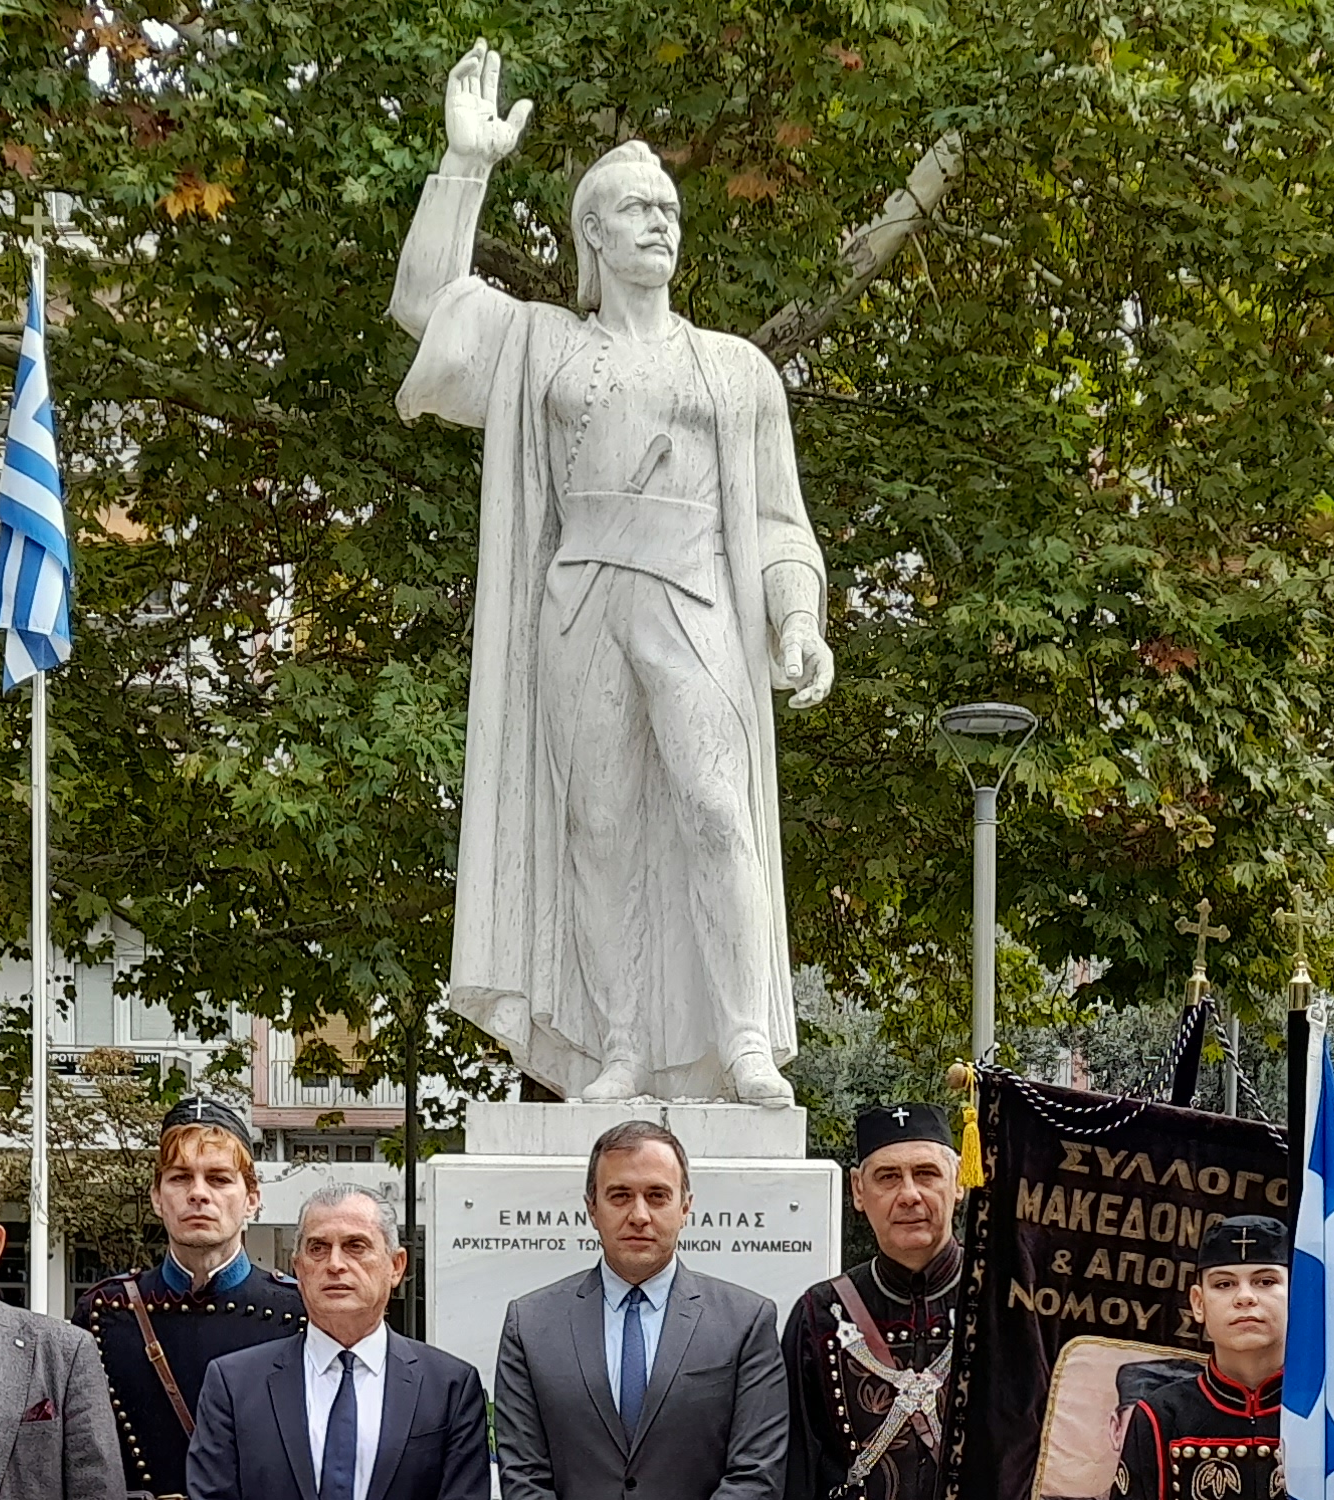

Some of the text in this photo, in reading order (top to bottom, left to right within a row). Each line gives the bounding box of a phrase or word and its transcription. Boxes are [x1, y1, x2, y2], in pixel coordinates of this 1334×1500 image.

[452, 1238, 566, 1251] ΑΡΧΙΣΤΡΑΤΗΓΟΣ
[731, 1240, 812, 1253] ΔΥΝΑΜΕΩΝ
[1051, 1249, 1072, 1276] &
[1007, 1277, 1161, 1331] ΝΟΜΟΥ
